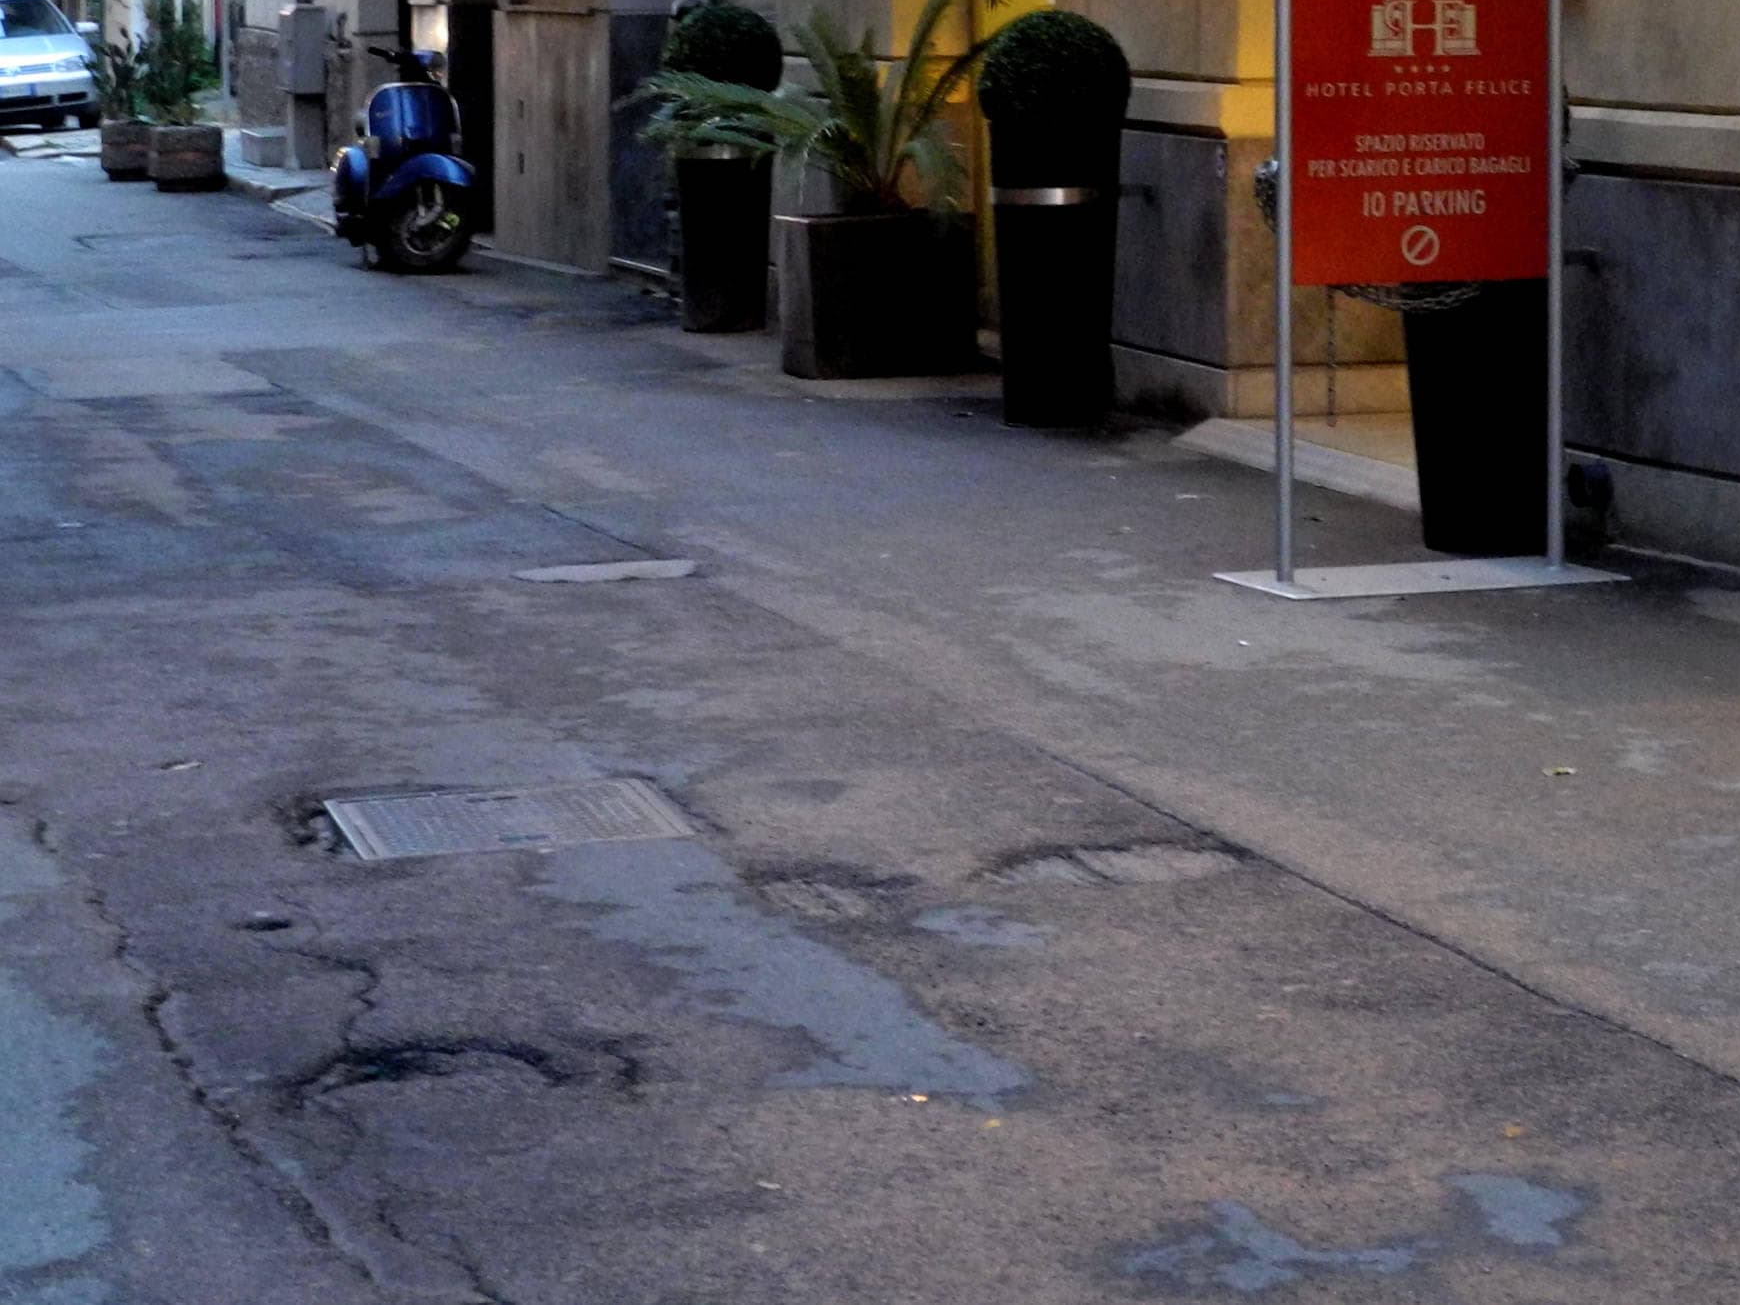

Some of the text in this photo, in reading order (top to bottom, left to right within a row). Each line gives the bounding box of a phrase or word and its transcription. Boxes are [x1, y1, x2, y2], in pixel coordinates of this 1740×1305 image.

[1305, 79, 1532, 97] HOTEL PORTA FELICE
[1355, 132, 1486, 153] SPAZIO RISERVATO
[1308, 155, 1531, 177] PER SCARICO E CARICO BAGAGLI
[1392, 188, 1487, 216] PARKING
